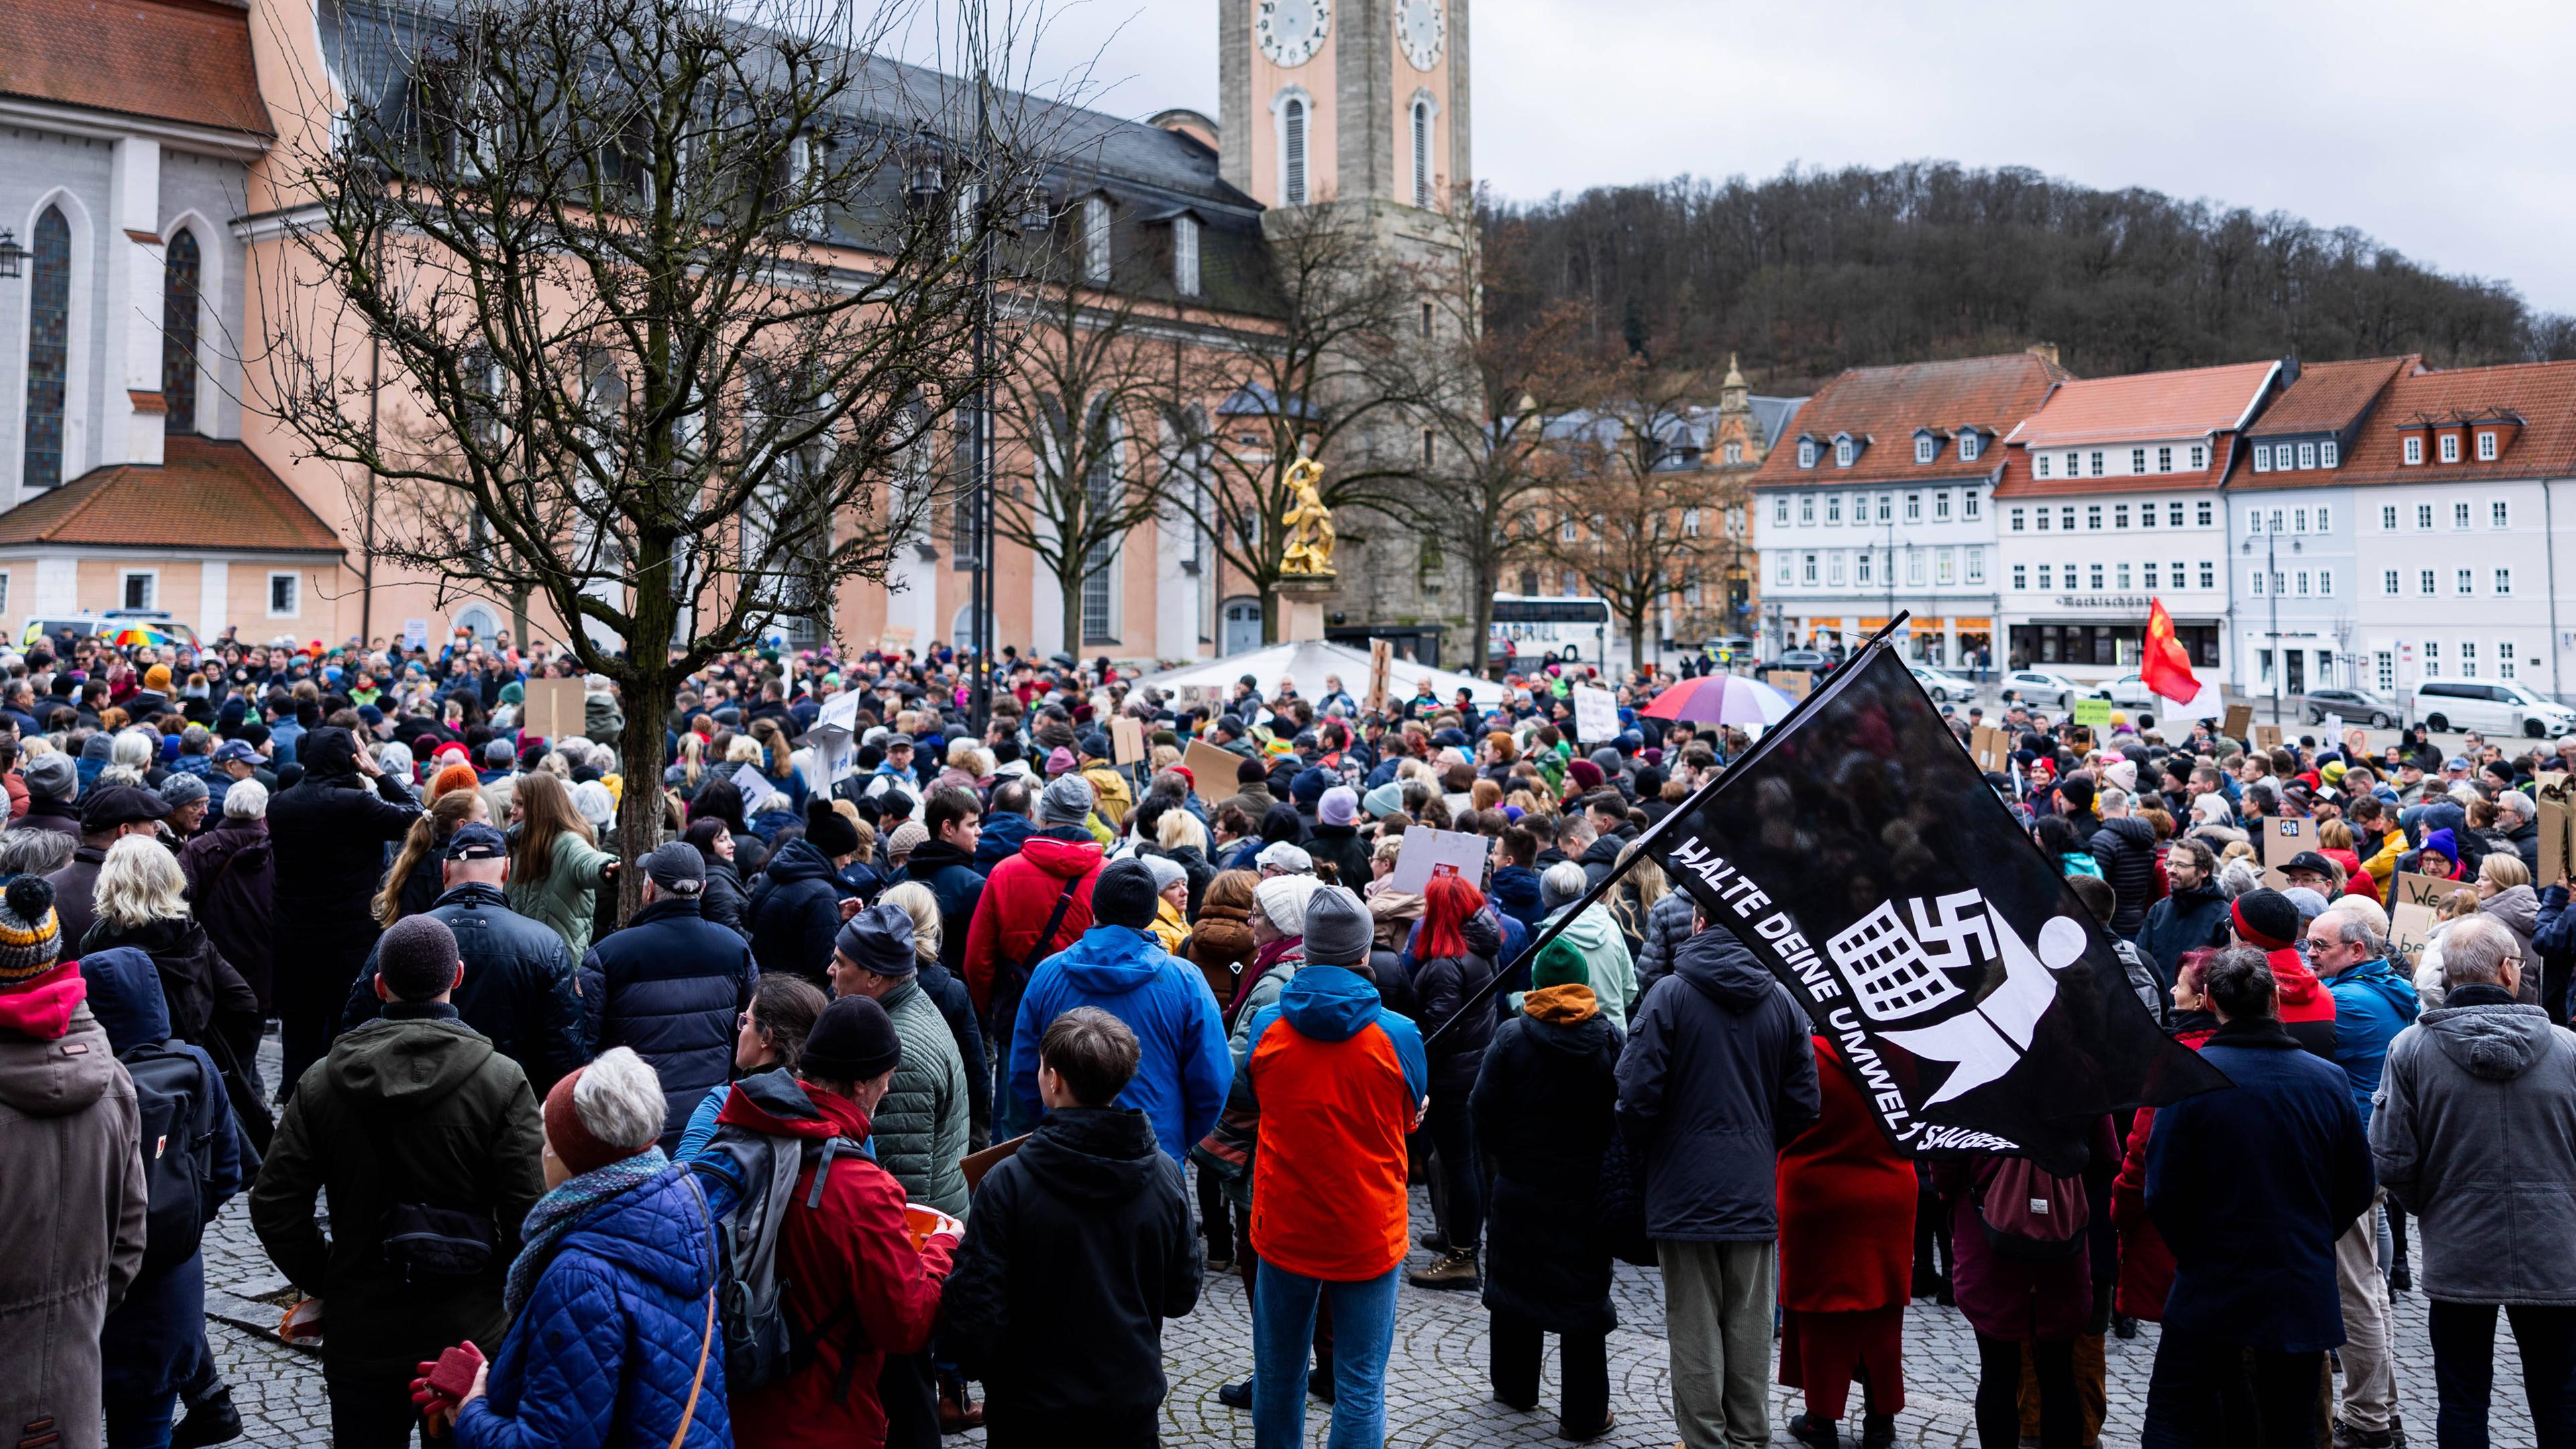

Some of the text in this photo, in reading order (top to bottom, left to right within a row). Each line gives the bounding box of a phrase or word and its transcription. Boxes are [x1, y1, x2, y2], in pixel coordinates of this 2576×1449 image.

[2408, 881, 2440, 907] We
[1668, 836, 2019, 1150] HALTE DEINE UMWELT SAUBER
